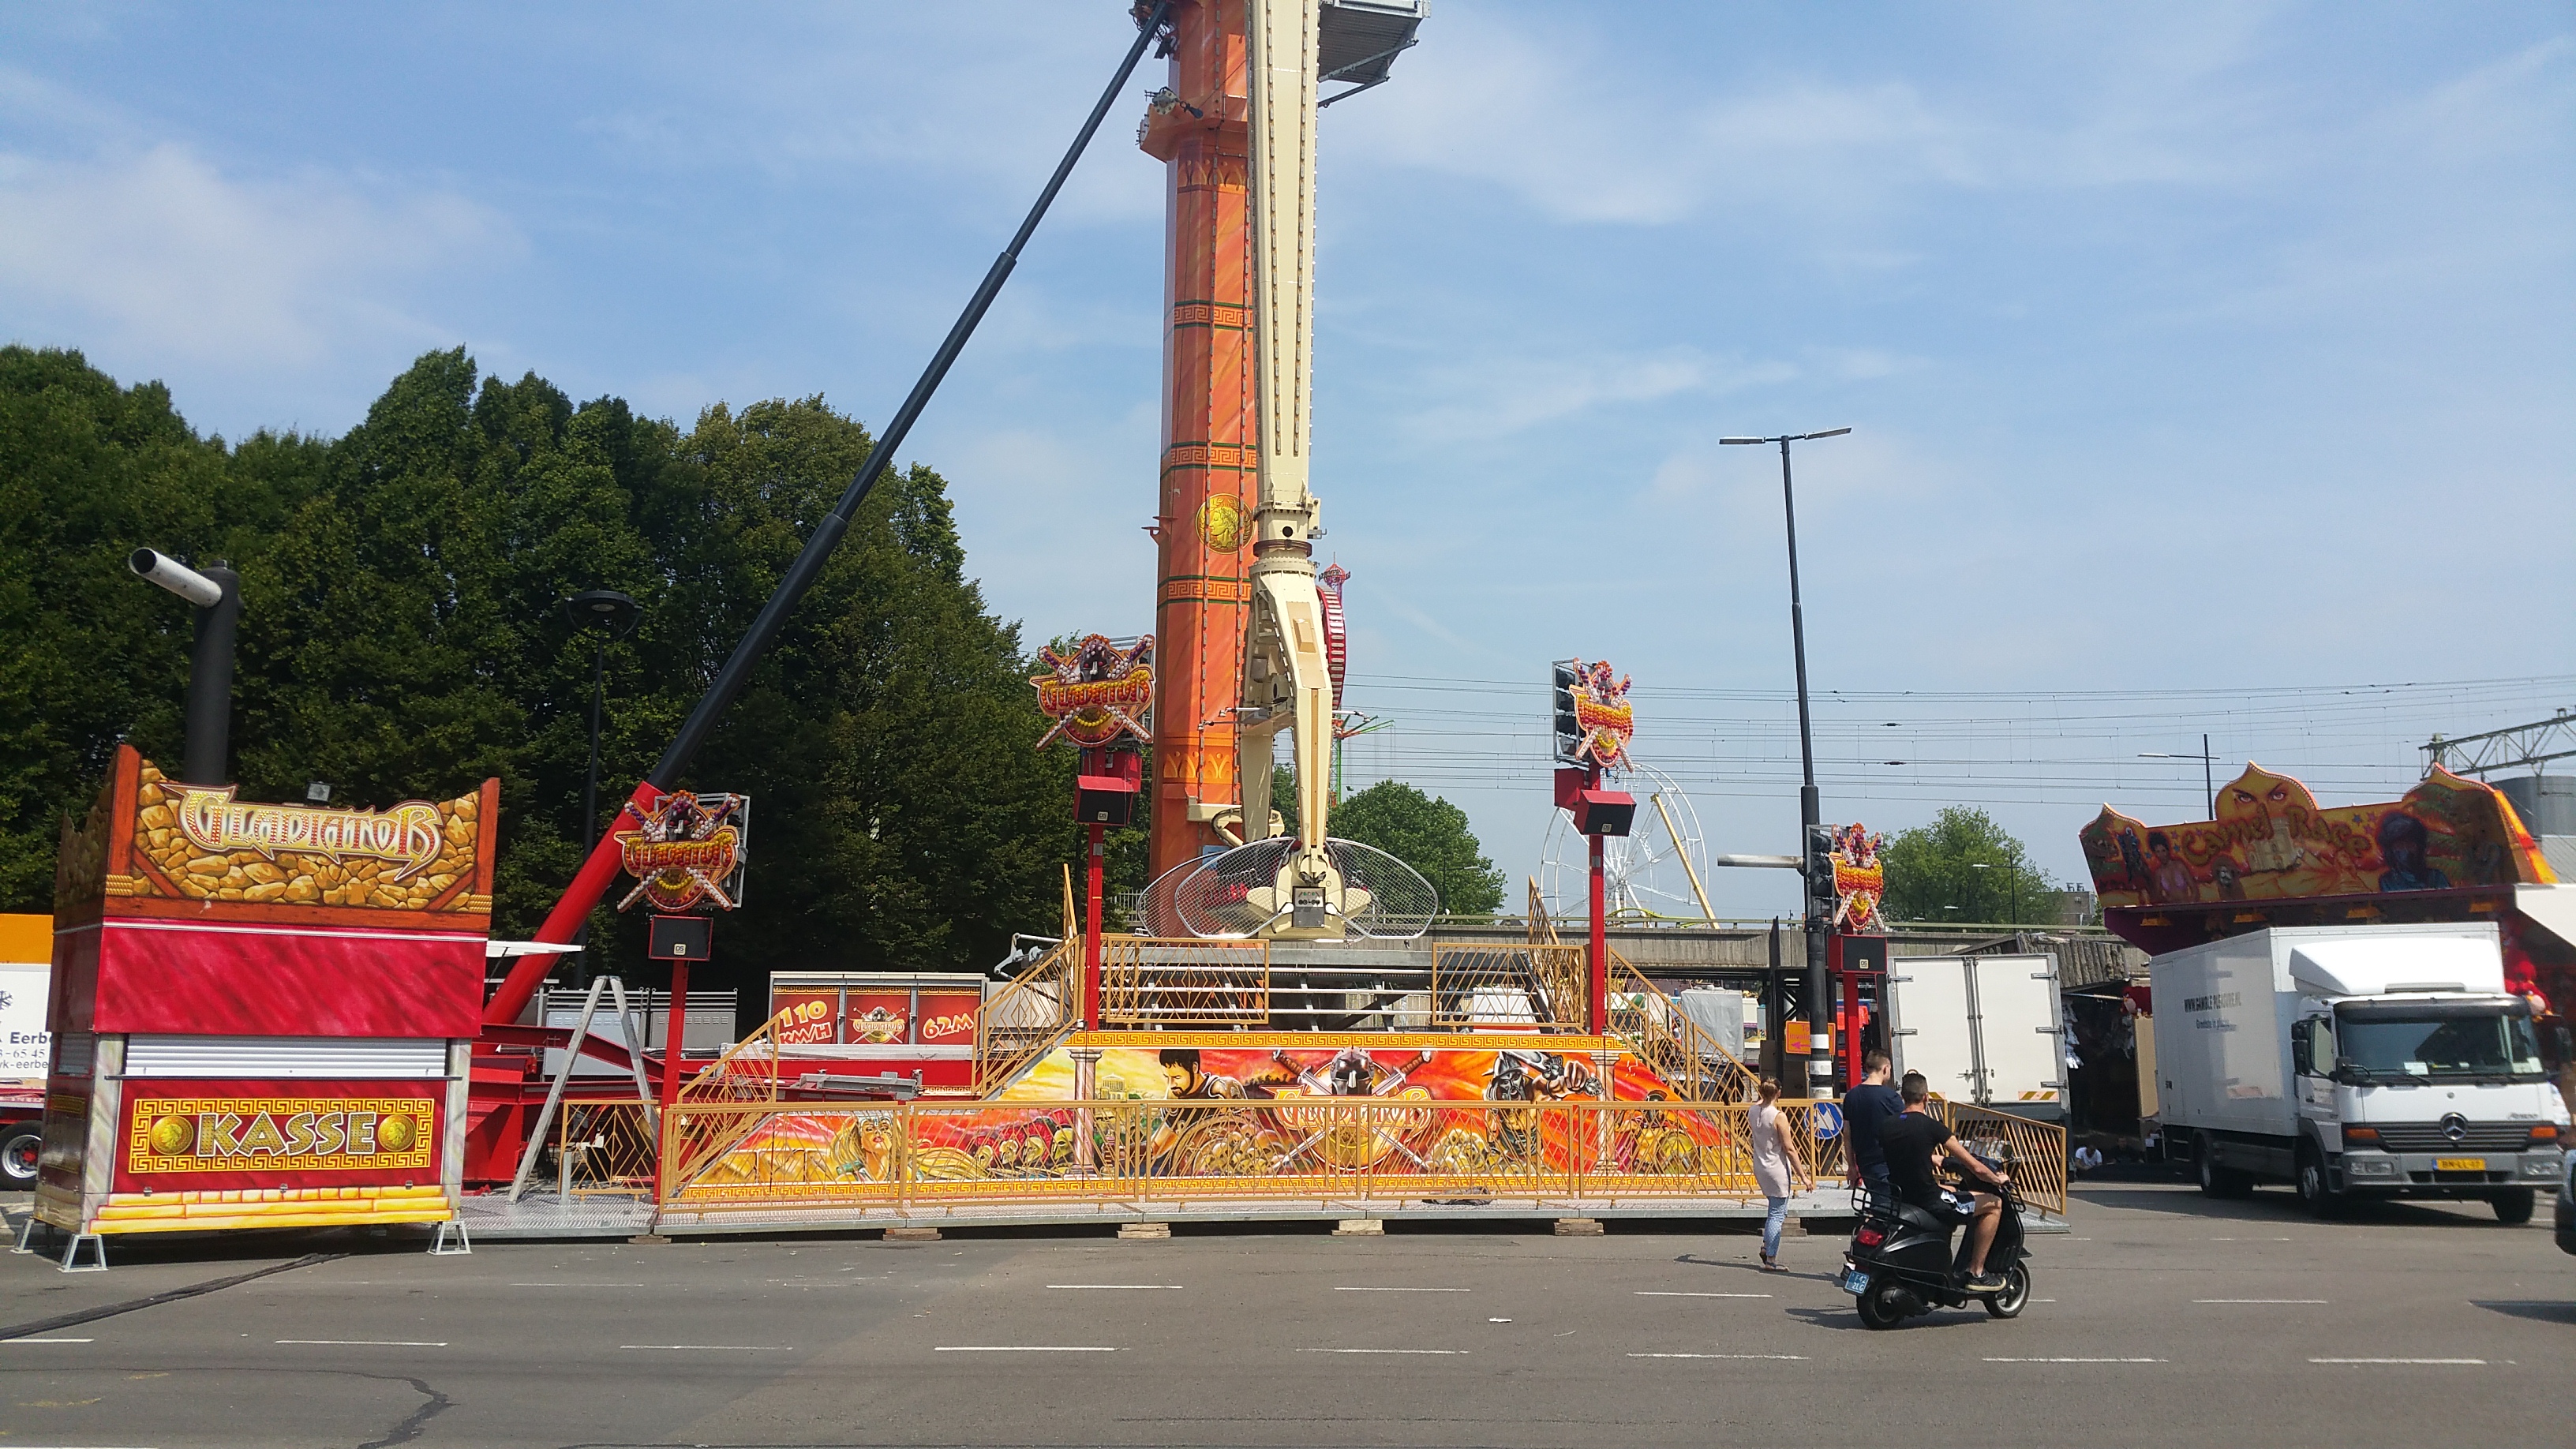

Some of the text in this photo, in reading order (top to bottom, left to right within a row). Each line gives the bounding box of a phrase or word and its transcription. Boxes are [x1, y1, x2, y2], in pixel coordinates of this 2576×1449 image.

[779, 1000, 828, 1028] 110
[923, 1013, 975, 1039] 62M
[778, 1021, 833, 1044] KM/H
[196, 1111, 377, 1158] KASSE
